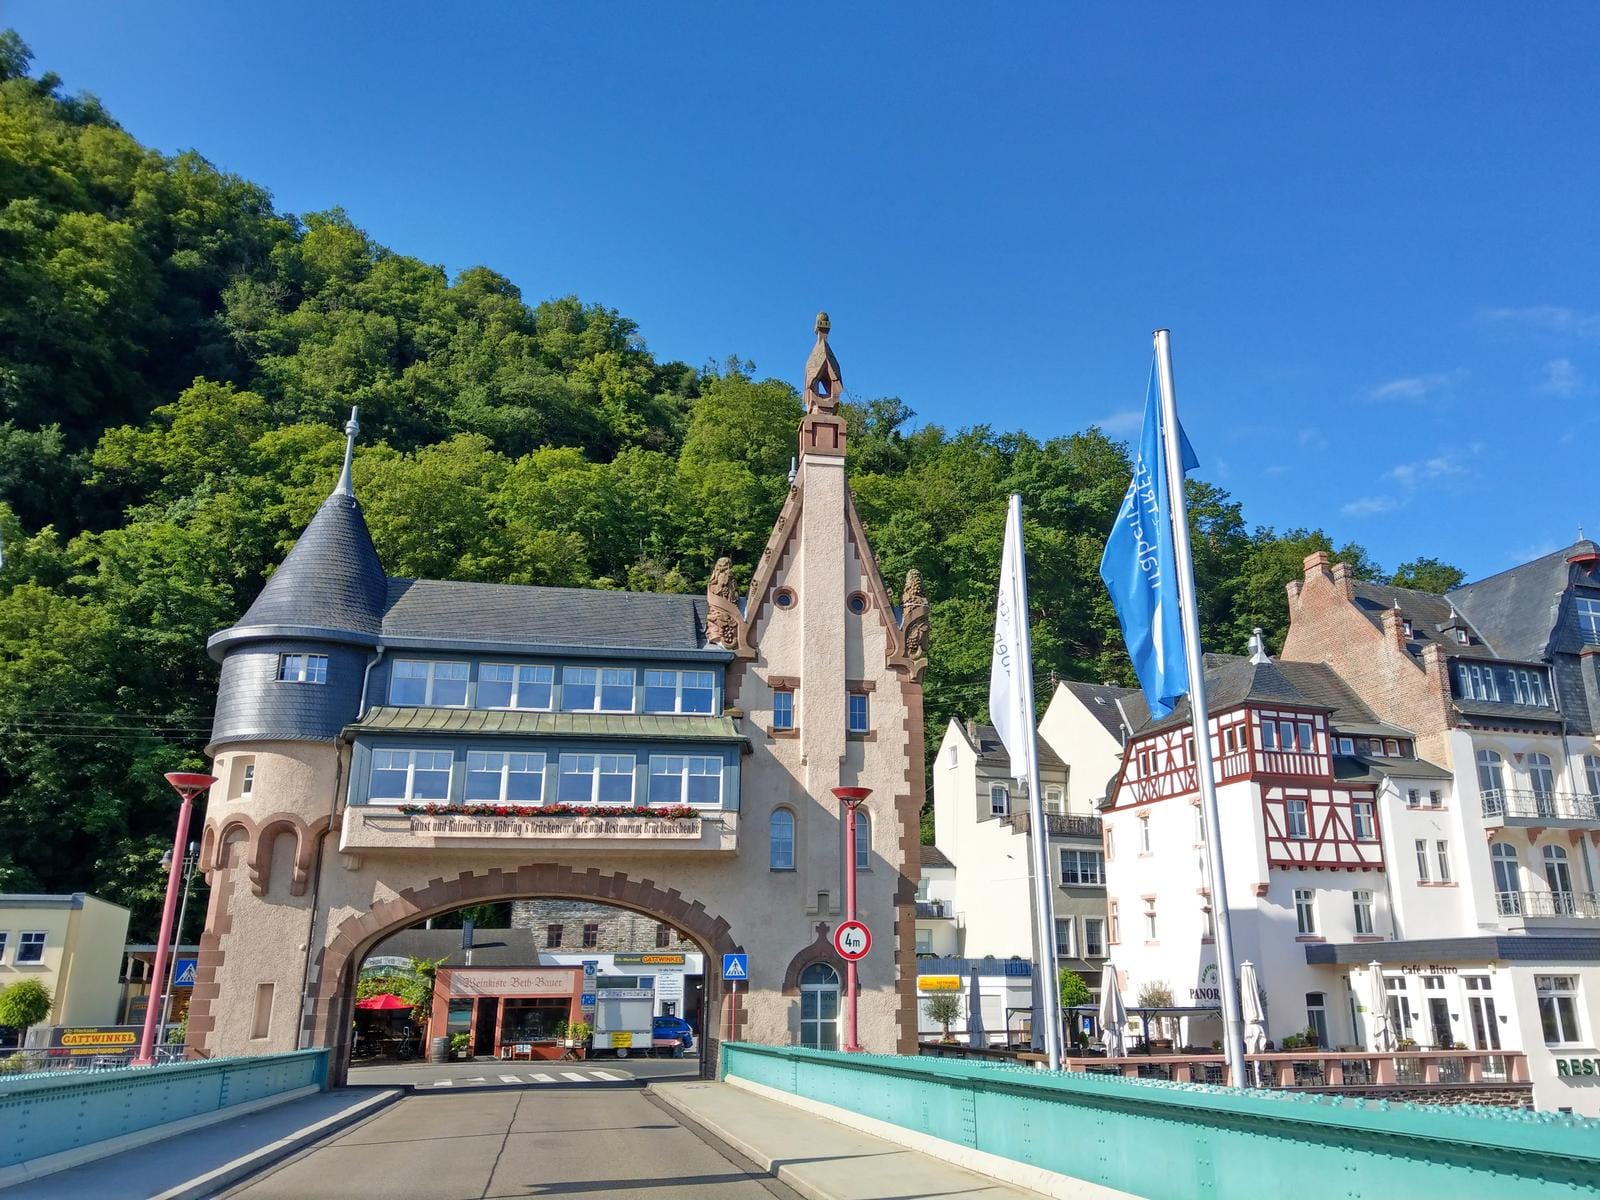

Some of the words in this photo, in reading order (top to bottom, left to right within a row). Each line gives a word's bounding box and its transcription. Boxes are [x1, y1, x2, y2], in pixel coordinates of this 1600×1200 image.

[409, 819, 431, 832] Kunst
[432, 819, 447, 832] und
[448, 819, 482, 833] Kulinarik
[483, 820, 492, 833] in
[530, 820, 572, 834] Brückentor
[589, 821, 603, 834] und
[604, 821, 643, 834] Restaurant
[1401, 964, 1421, 975] Café
[1429, 964, 1458, 975] Bistro
[463, 977, 507, 988] Weinkiste
[63, 1033, 134, 1044] GATTWINKEL
